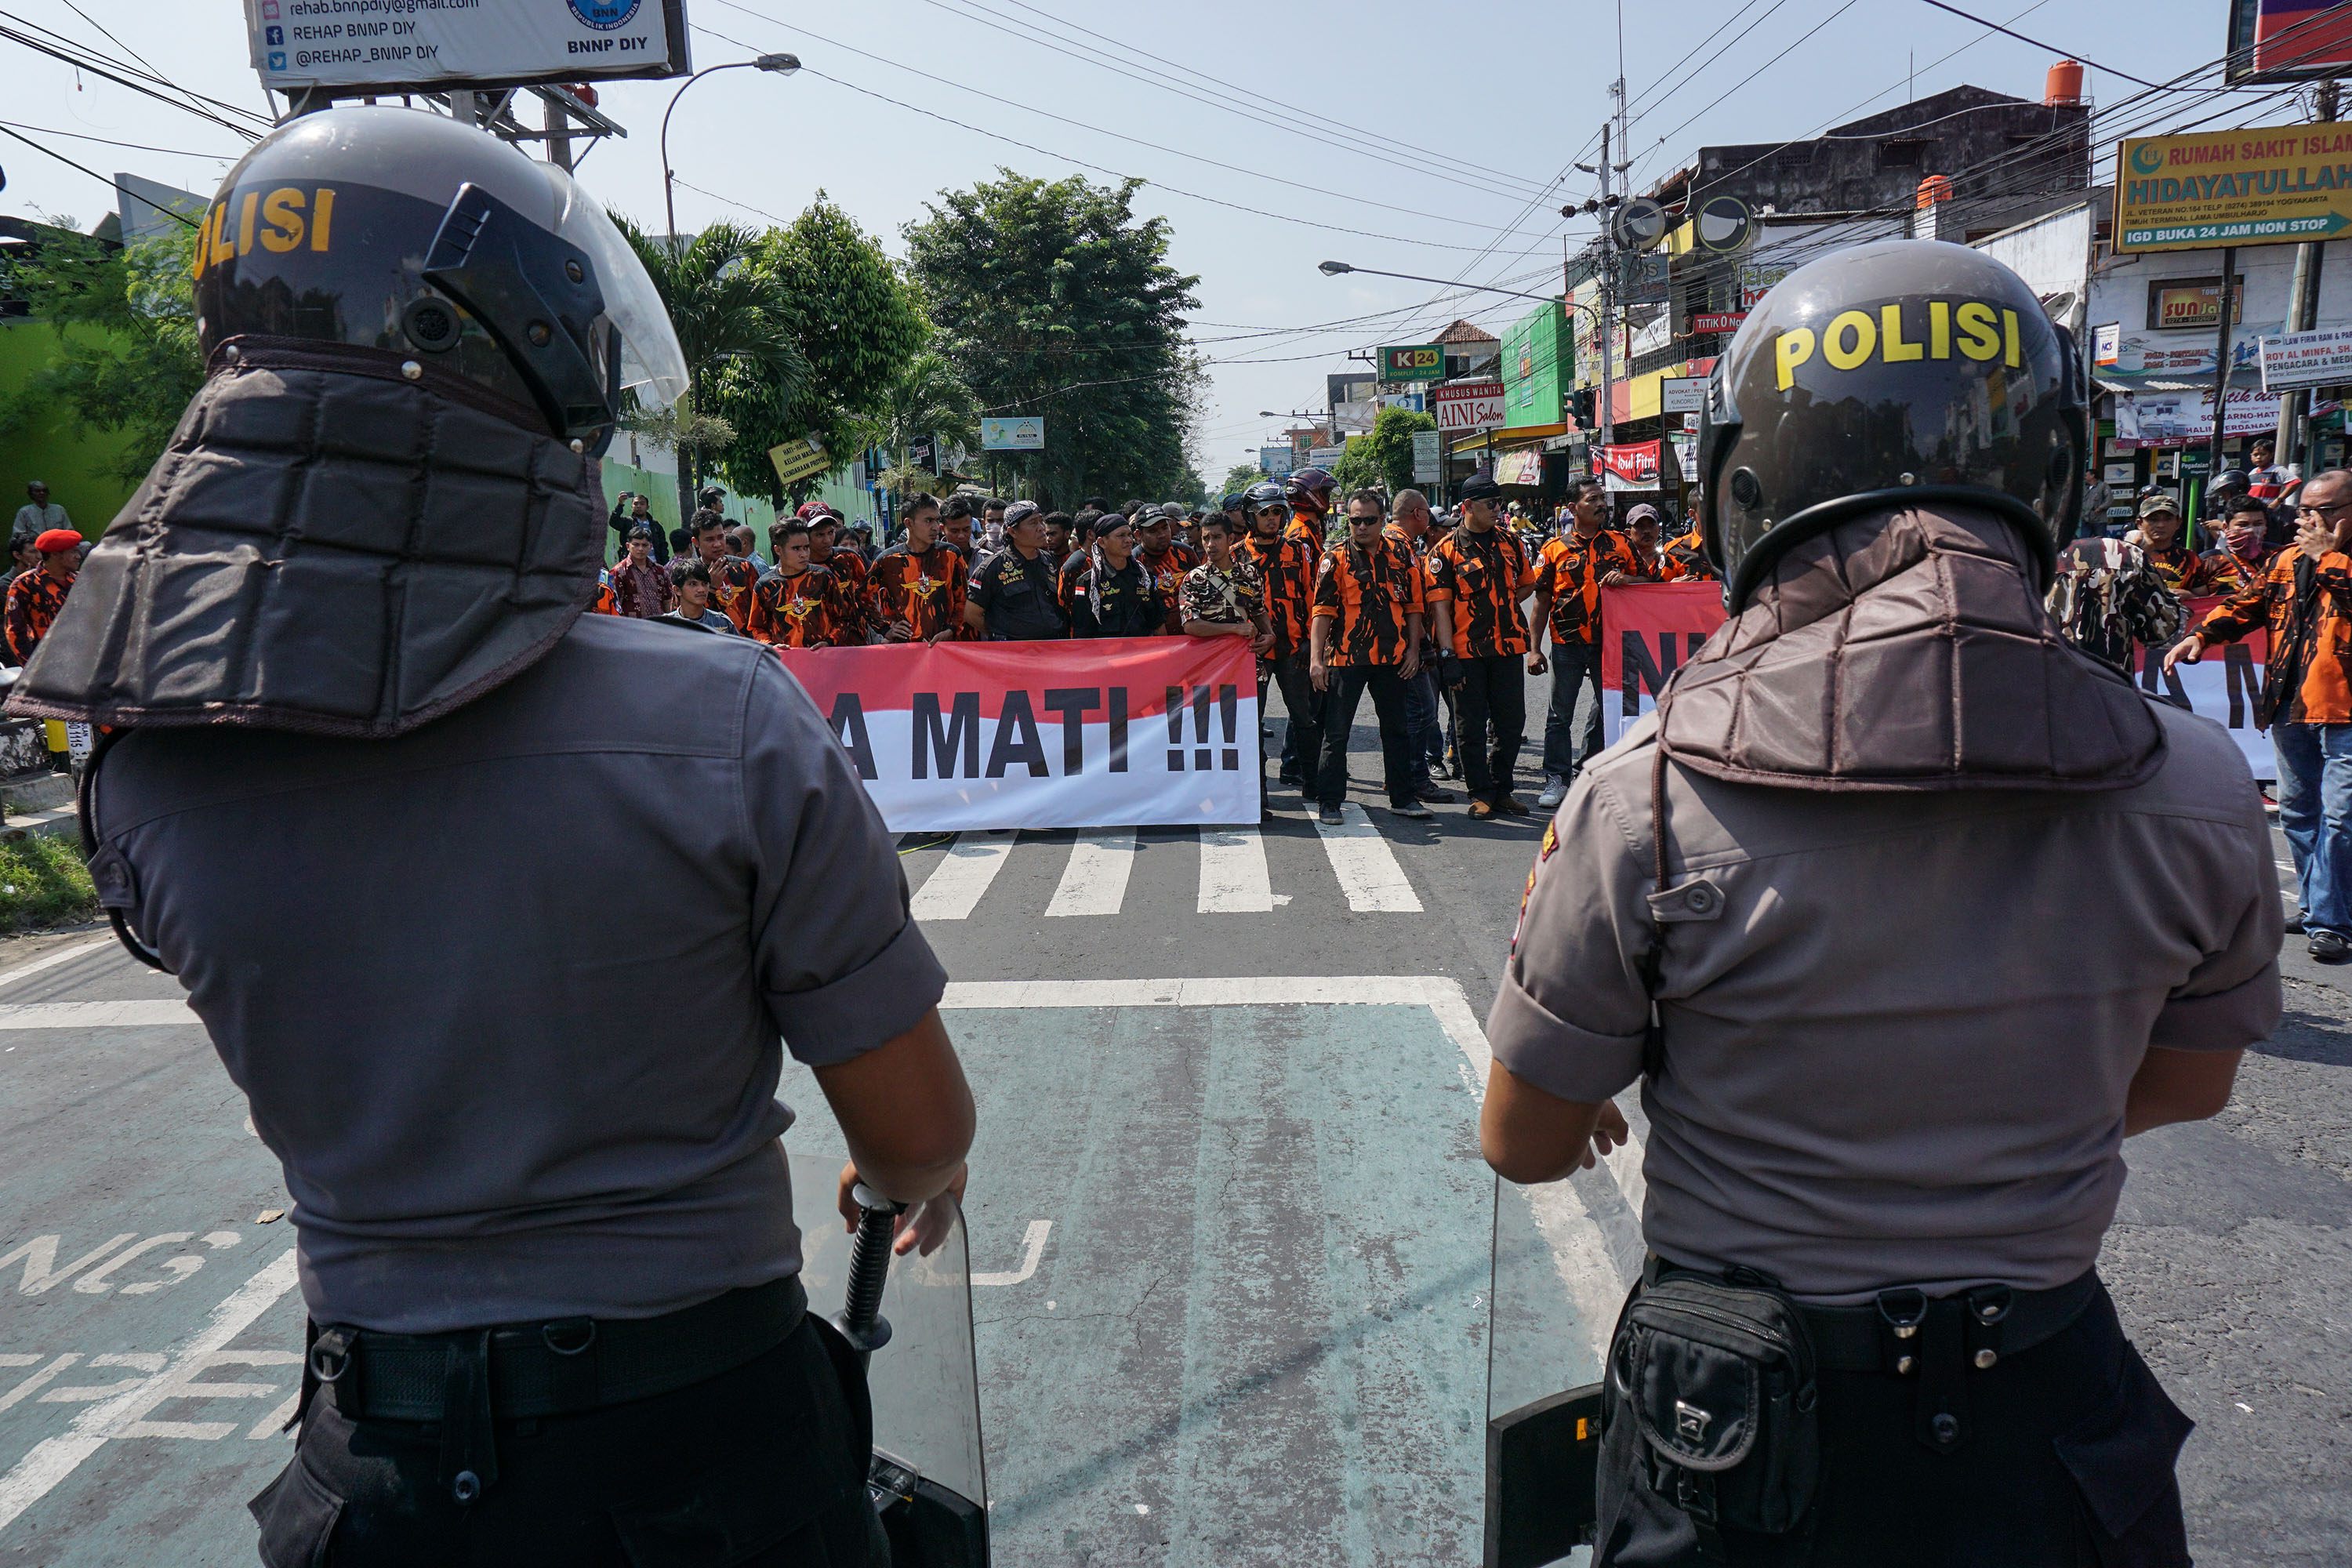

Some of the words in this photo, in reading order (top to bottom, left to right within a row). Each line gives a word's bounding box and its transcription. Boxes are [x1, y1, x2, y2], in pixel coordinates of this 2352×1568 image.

[571, 5, 604, 30] REPUBLIK
[605, 3, 639, 30] INDONESIA
[593, 8, 619, 17] BNN
[293, 25, 342, 40] REHAP
[347, 22, 389, 37] BNNP
[393, 21, 416, 35] DIY
[568, 40, 614, 53] BNNP
[619, 37, 648, 51] DIY
[296, 46, 412, 67] @REHAP_BNNP
[417, 45, 439, 60] DIY
[2169, 143, 2234, 166] RUMAH
[2241, 139, 2298, 161] SAKIT
[2139, 208, 2173, 216] VETERAN
[2277, 196, 2328, 205] YOGYAKARTA
[2151, 216, 2189, 224] TERMINAL
[2127, 230, 2151, 243] IGD
[2156, 227, 2197, 241] BUKA
[2200, 224, 2217, 238] 24
[2220, 223, 2251, 237] JAM
[2255, 220, 2285, 234] NON
[2290, 217, 2329, 231] STOP
[2165, 302, 2198, 317] SUN
[1776, 302, 2020, 392] POLISI
[2266, 352, 2285, 361] ROY
[2267, 359, 2318, 372] PENGACARA
[1440, 388, 1470, 399] KHUSUS
[1472, 386, 1501, 396] WANITA
[2201, 389, 2252, 406] Btik
[1439, 402, 1475, 427] AINI
[1476, 402, 1504, 424] Salon
[783, 463, 811, 477] KENDARAAN
[810, 456, 826, 468] PROYEK
[1617, 453, 1633, 470] Idul
[1636, 453, 1656, 469] Fitri
[912, 687, 1129, 779] MATI
[1166, 684, 1239, 771] !!!
